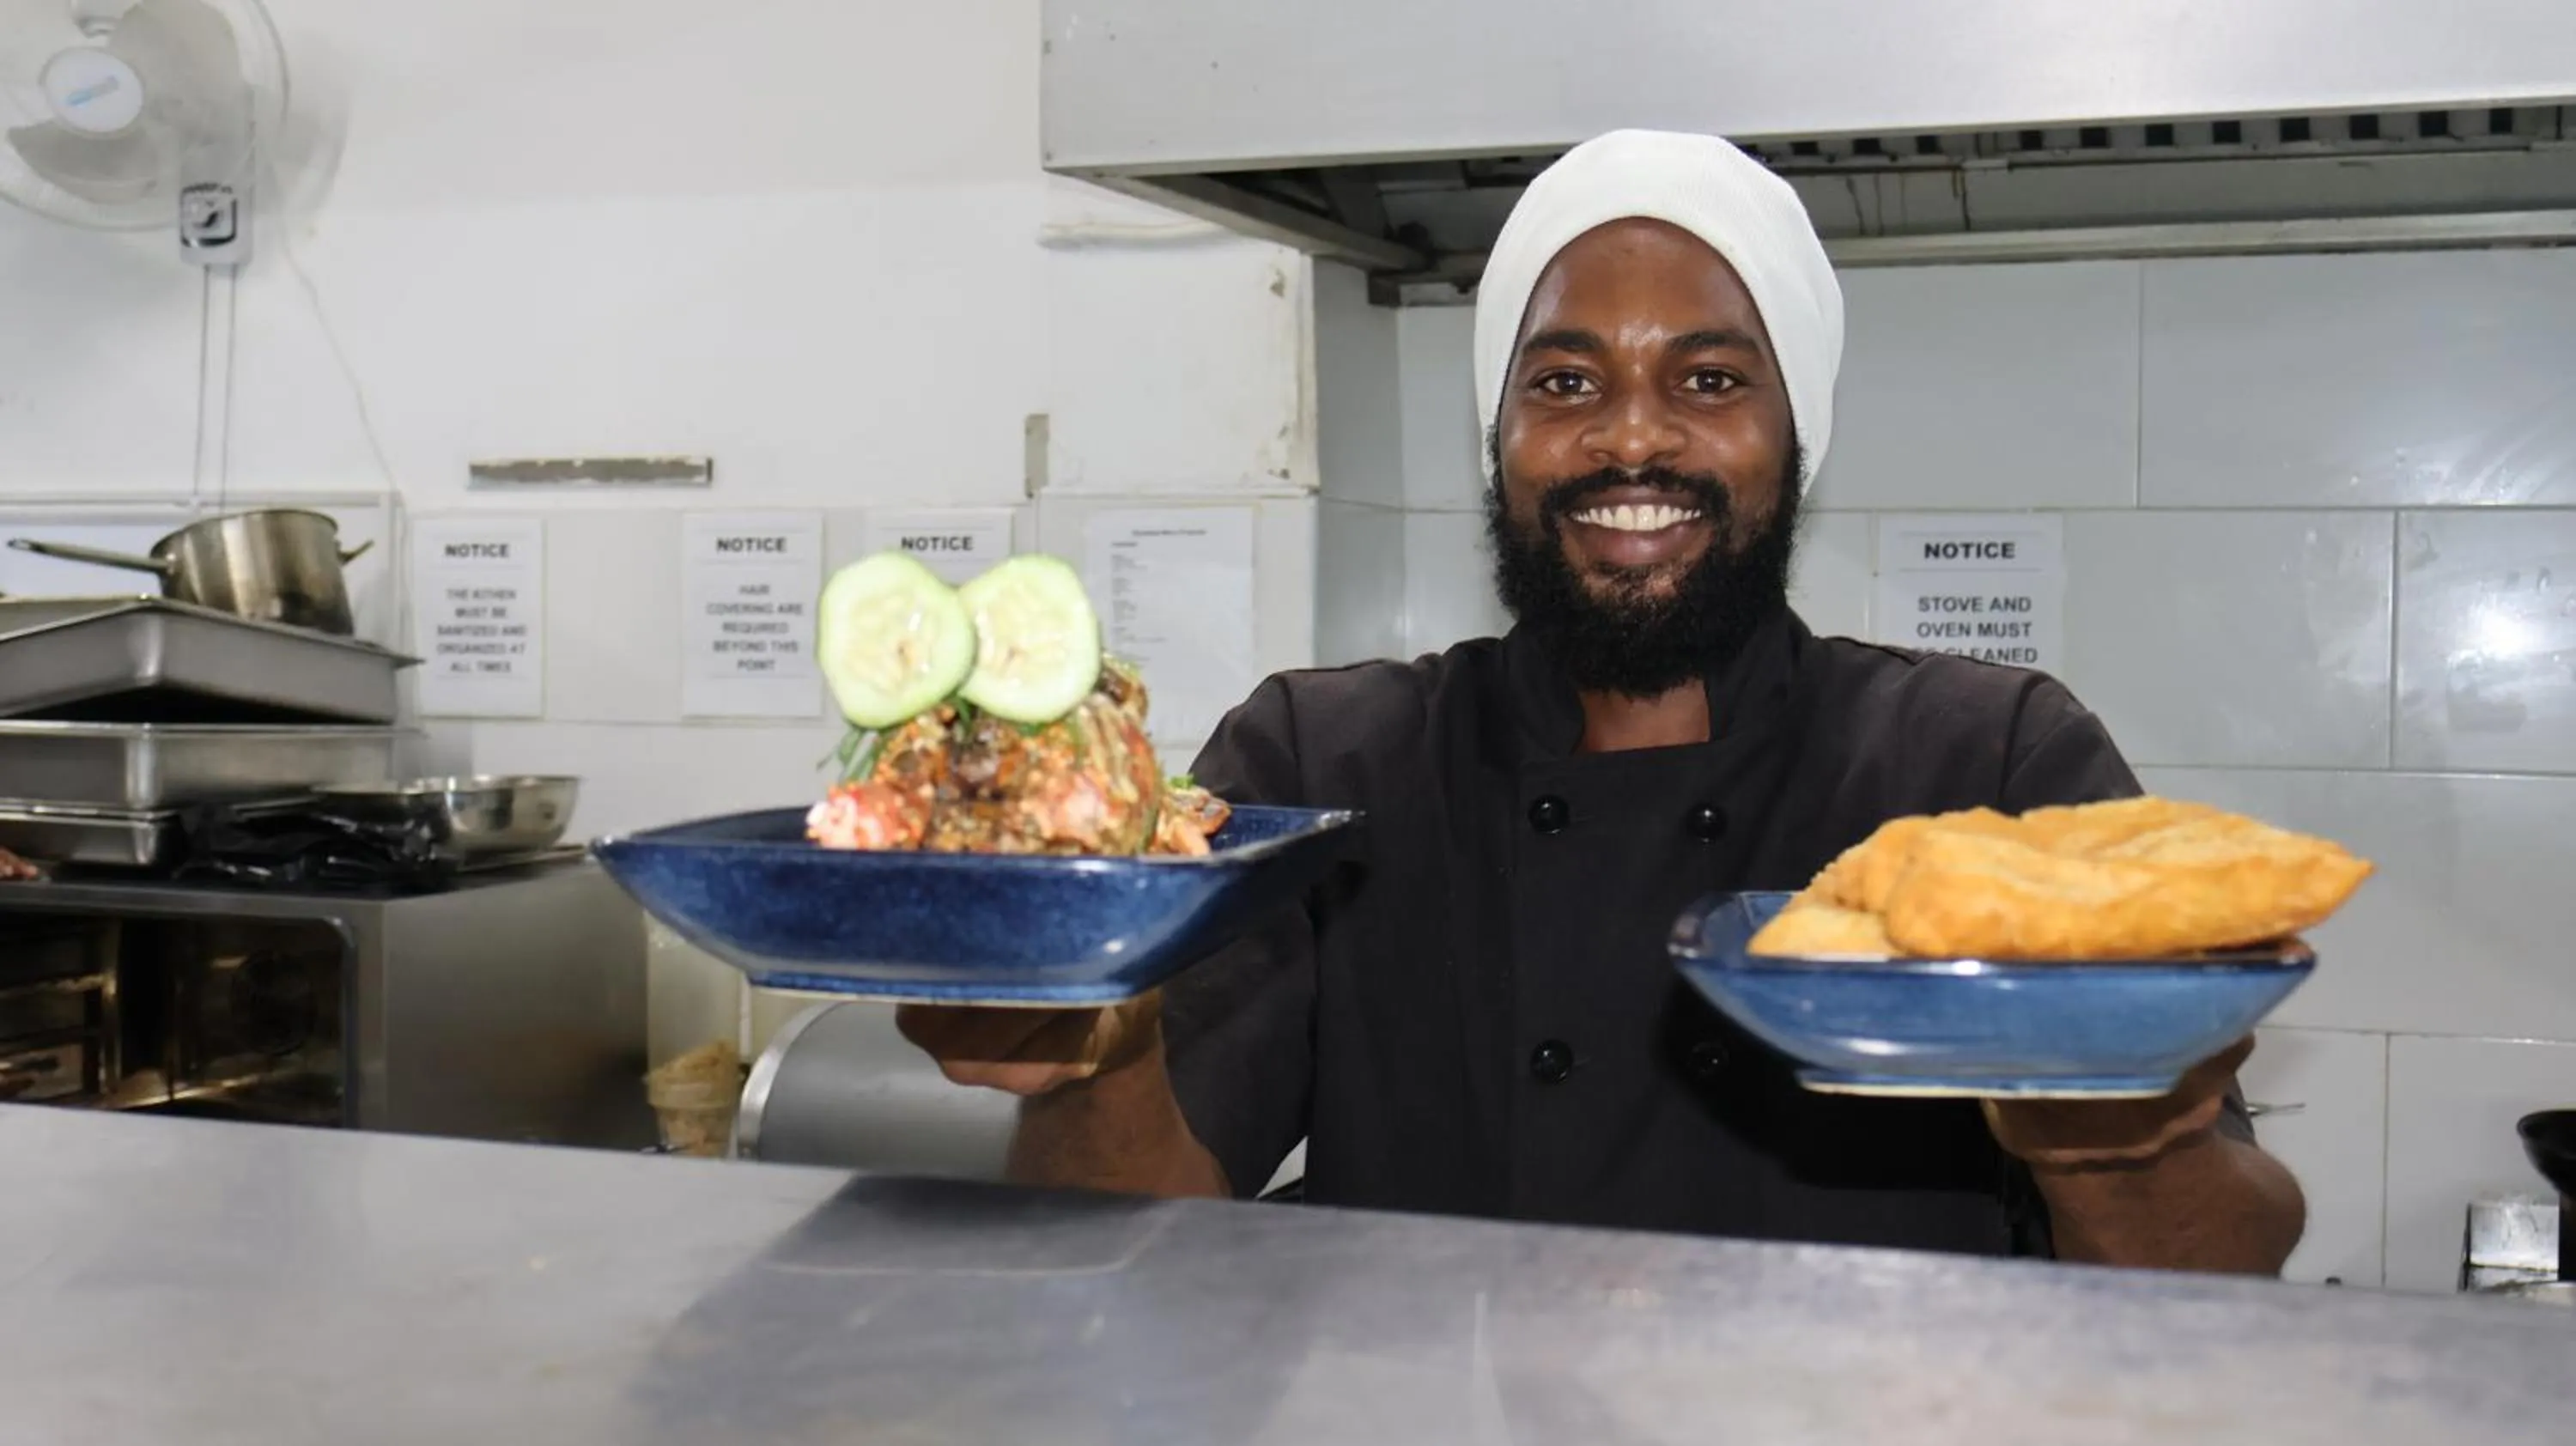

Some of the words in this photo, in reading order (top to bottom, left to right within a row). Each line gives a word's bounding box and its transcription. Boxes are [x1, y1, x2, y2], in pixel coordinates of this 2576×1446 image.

[445, 543, 509, 557] NOTICE
[717, 537, 787, 552] NOTICE
[901, 536, 974, 550] NOTICE
[1923, 542, 2016, 559] NOTICE
[707, 604, 774, 615] COVERING
[1917, 596, 1984, 612] STOVE
[1989, 596, 2032, 612] AND
[722, 623, 789, 633] REQUIRED
[1916, 621, 1971, 637] OVEN
[1977, 621, 2033, 637] MUST
[713, 641, 766, 652] BEYOND
[736, 659, 776, 671] POINT
